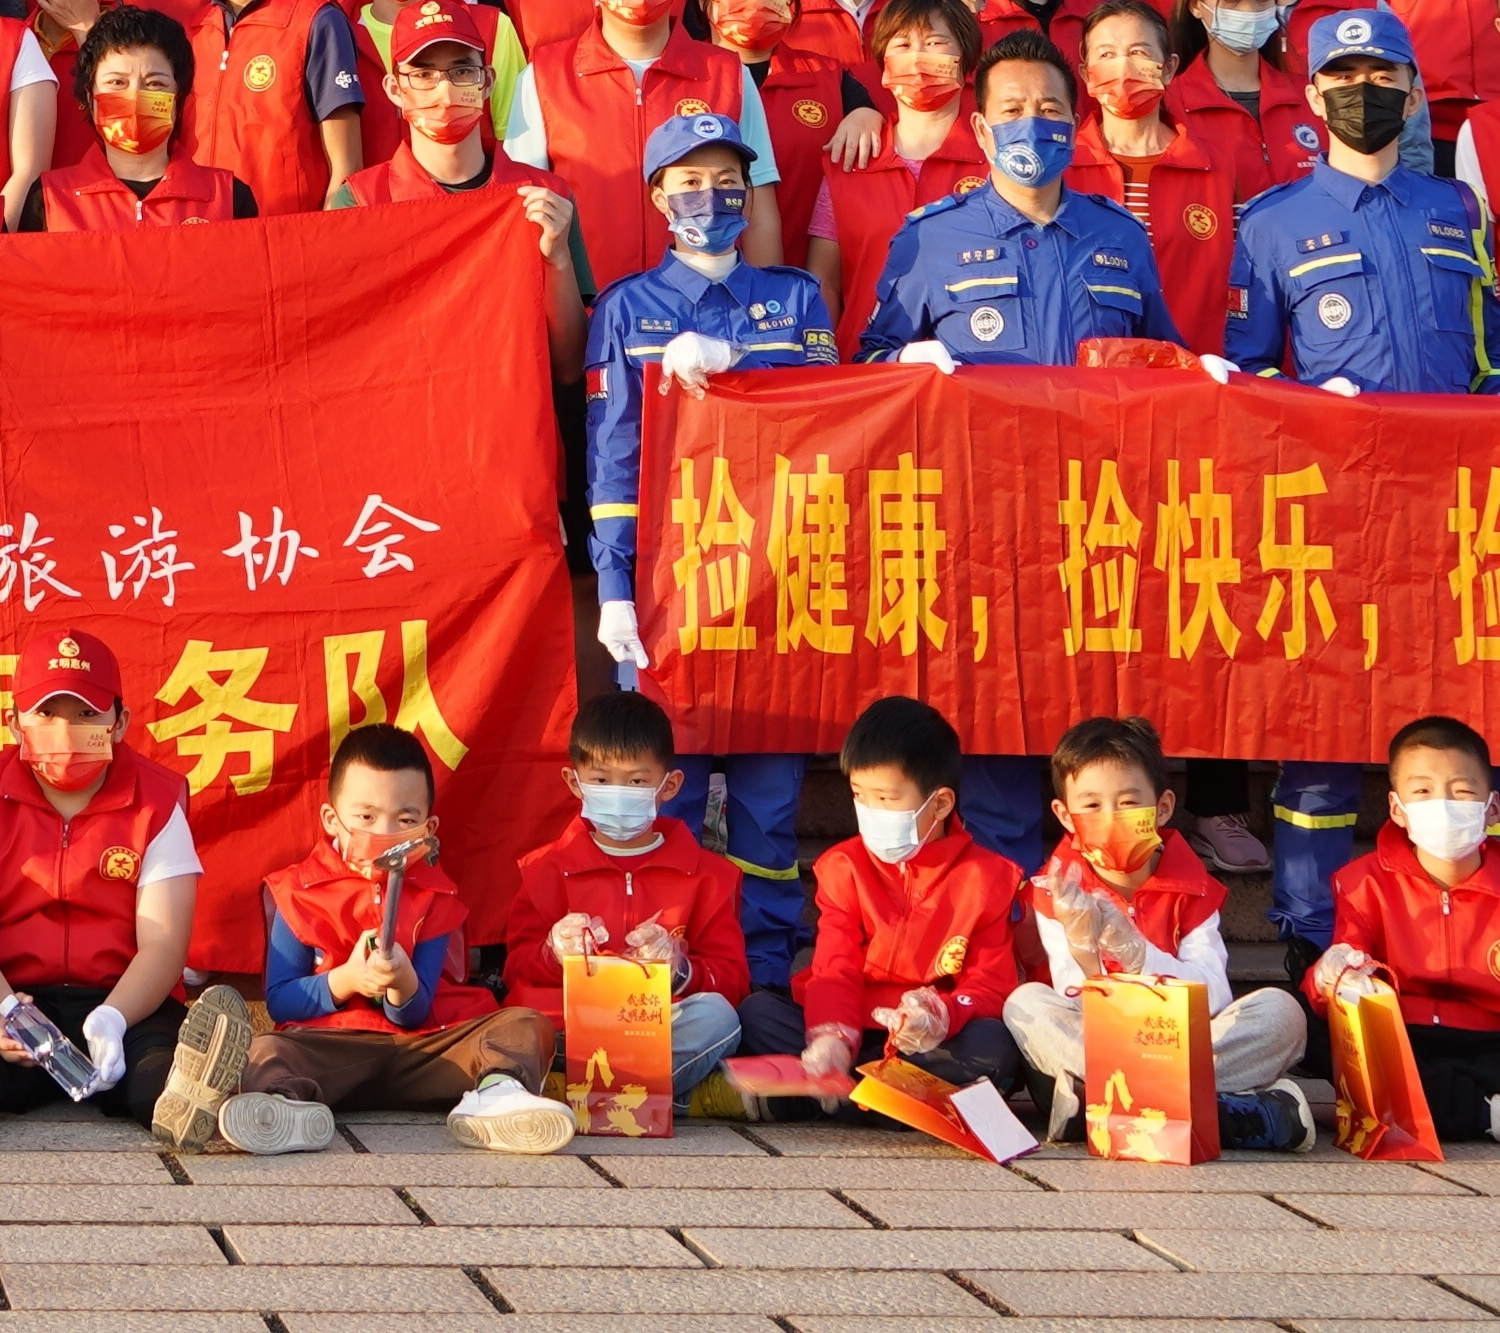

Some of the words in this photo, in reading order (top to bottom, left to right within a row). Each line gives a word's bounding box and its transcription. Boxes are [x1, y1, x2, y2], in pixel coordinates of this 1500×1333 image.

[48, 659, 91, 672] 文明惠州
[627, 993, 661, 1007] 我爱你
[616, 1006, 662, 1025] 文明惠州
[1144, 1015, 1178, 1030] 我爱你
[1134, 1030, 1181, 1050] 文明惠州
